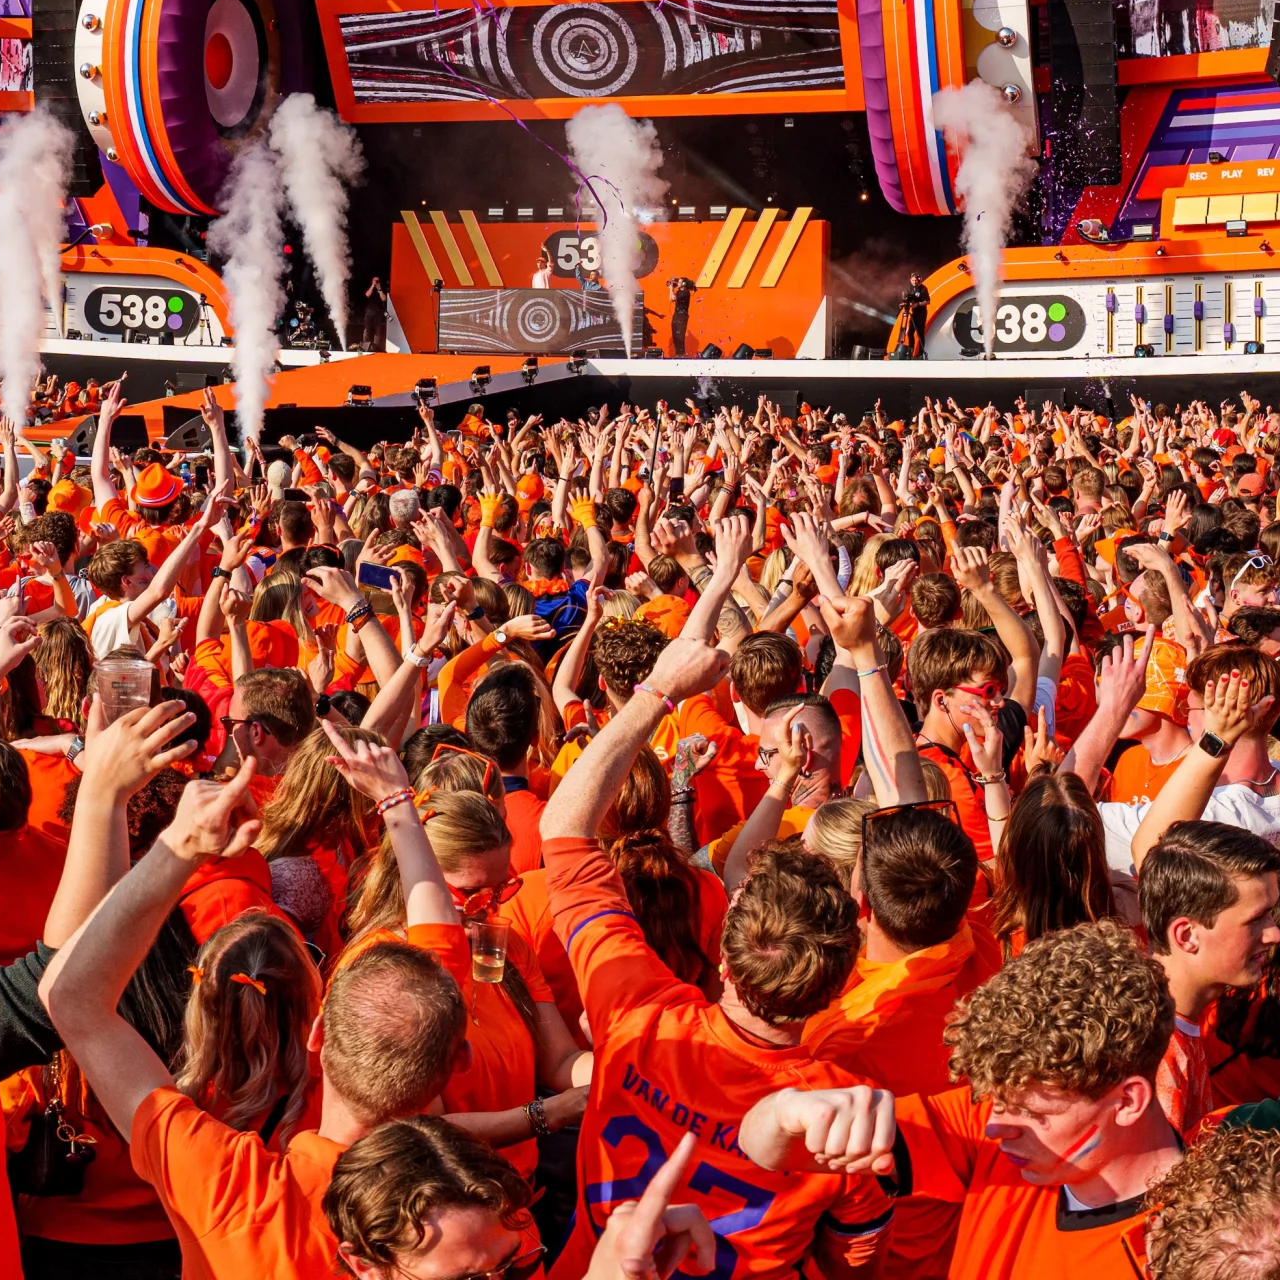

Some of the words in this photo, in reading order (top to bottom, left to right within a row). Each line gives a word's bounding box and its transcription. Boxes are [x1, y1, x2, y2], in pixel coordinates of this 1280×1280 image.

[1189, 171, 1208, 181] REC
[1221, 169, 1243, 180] PLAY
[1257, 167, 1275, 177] REV
[99, 293, 167, 329] 538
[970, 303, 1048, 344] 538
[620, 1063, 671, 1114] VAN
[671, 1101, 709, 1137] DE
